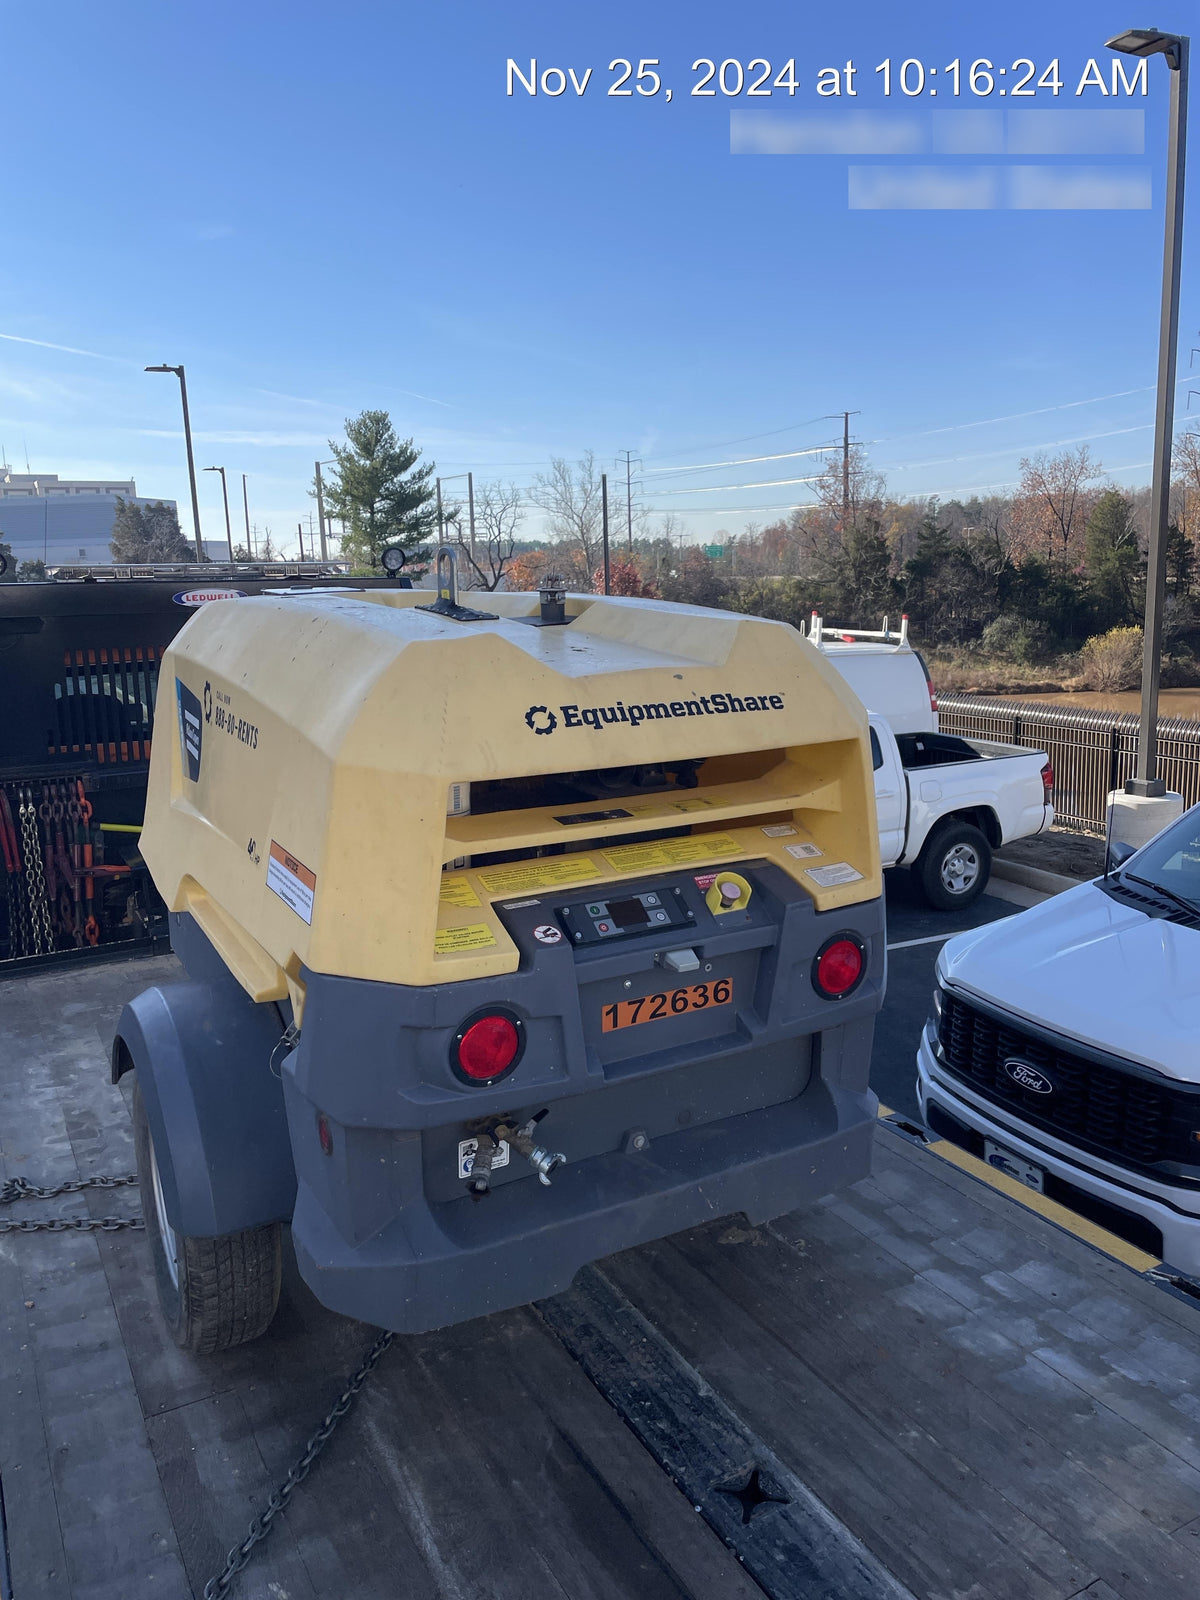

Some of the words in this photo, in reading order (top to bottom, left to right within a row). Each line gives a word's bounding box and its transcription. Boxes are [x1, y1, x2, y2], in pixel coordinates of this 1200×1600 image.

[215, 705, 259, 750] 888-80-RENTS
[560, 693, 784, 729] EquipmentShare
[604, 979, 731, 1029] 172636
[1013, 1066, 1043, 1091] Ford
